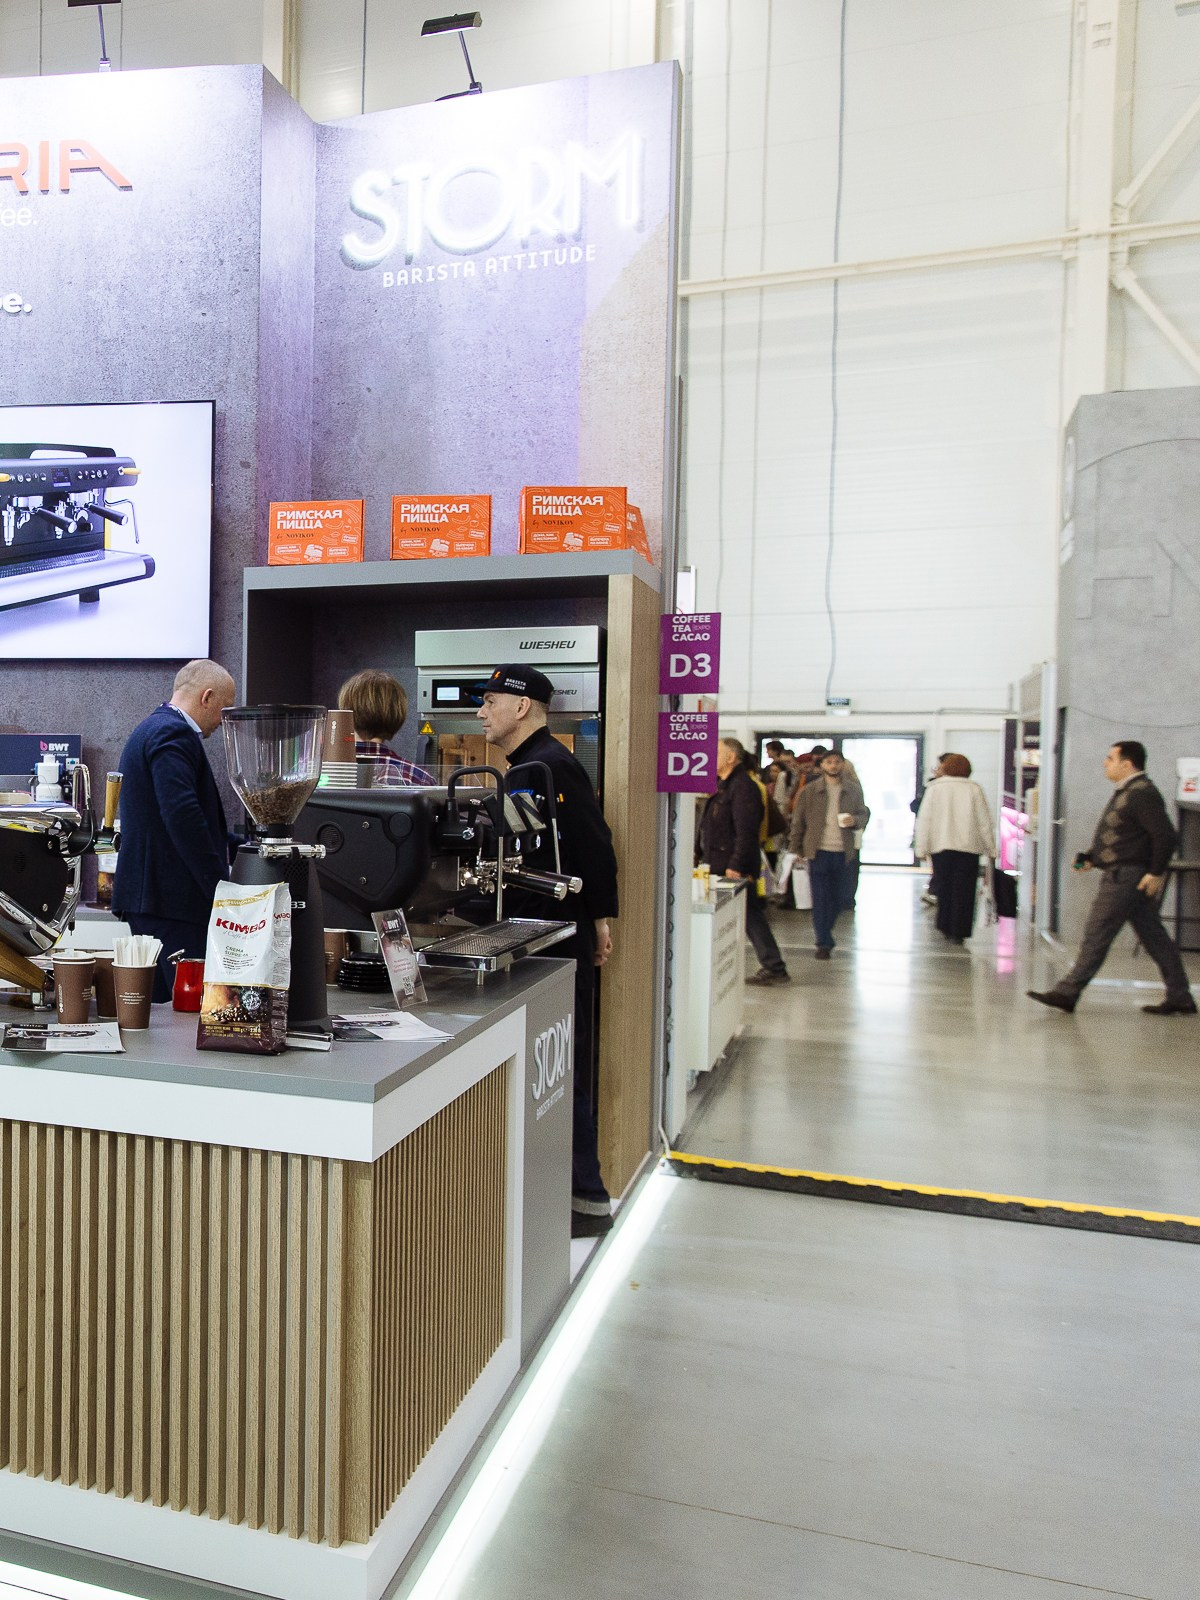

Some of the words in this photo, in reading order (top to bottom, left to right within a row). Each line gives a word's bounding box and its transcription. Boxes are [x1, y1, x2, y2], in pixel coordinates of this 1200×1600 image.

[340, 128, 645, 271] STORM
[382, 260, 477, 288] BARISTA
[484, 244, 597, 275] ATTITUDE
[532, 495, 604, 506] РИМСКАЯ
[401, 503, 470, 514] РИМСКАЯ
[532, 505, 583, 516] ПИЦЦА
[277, 509, 343, 520] РИМСКАЯ
[400, 513, 449, 523] ПИЦЦА
[276, 520, 323, 530] ПИЦЦА
[672, 615, 711, 624] COFFEE
[672, 633, 710, 641] CACAO
[519, 640, 576, 650] WIESHEU
[669, 653, 712, 678] D3
[504, 682, 526, 691] ATTITUDE
[506, 678, 527, 686] BARISTA
[670, 714, 708, 723] COFFEE
[670, 723, 689, 731] TEA
[669, 732, 708, 740] CACAO
[48, 743, 70, 751] BWT
[667, 752, 709, 776] D2
[216, 917, 267, 935] KIMBO
[225, 945, 244, 953] CREMA
[531, 1013, 572, 1101] STORM
